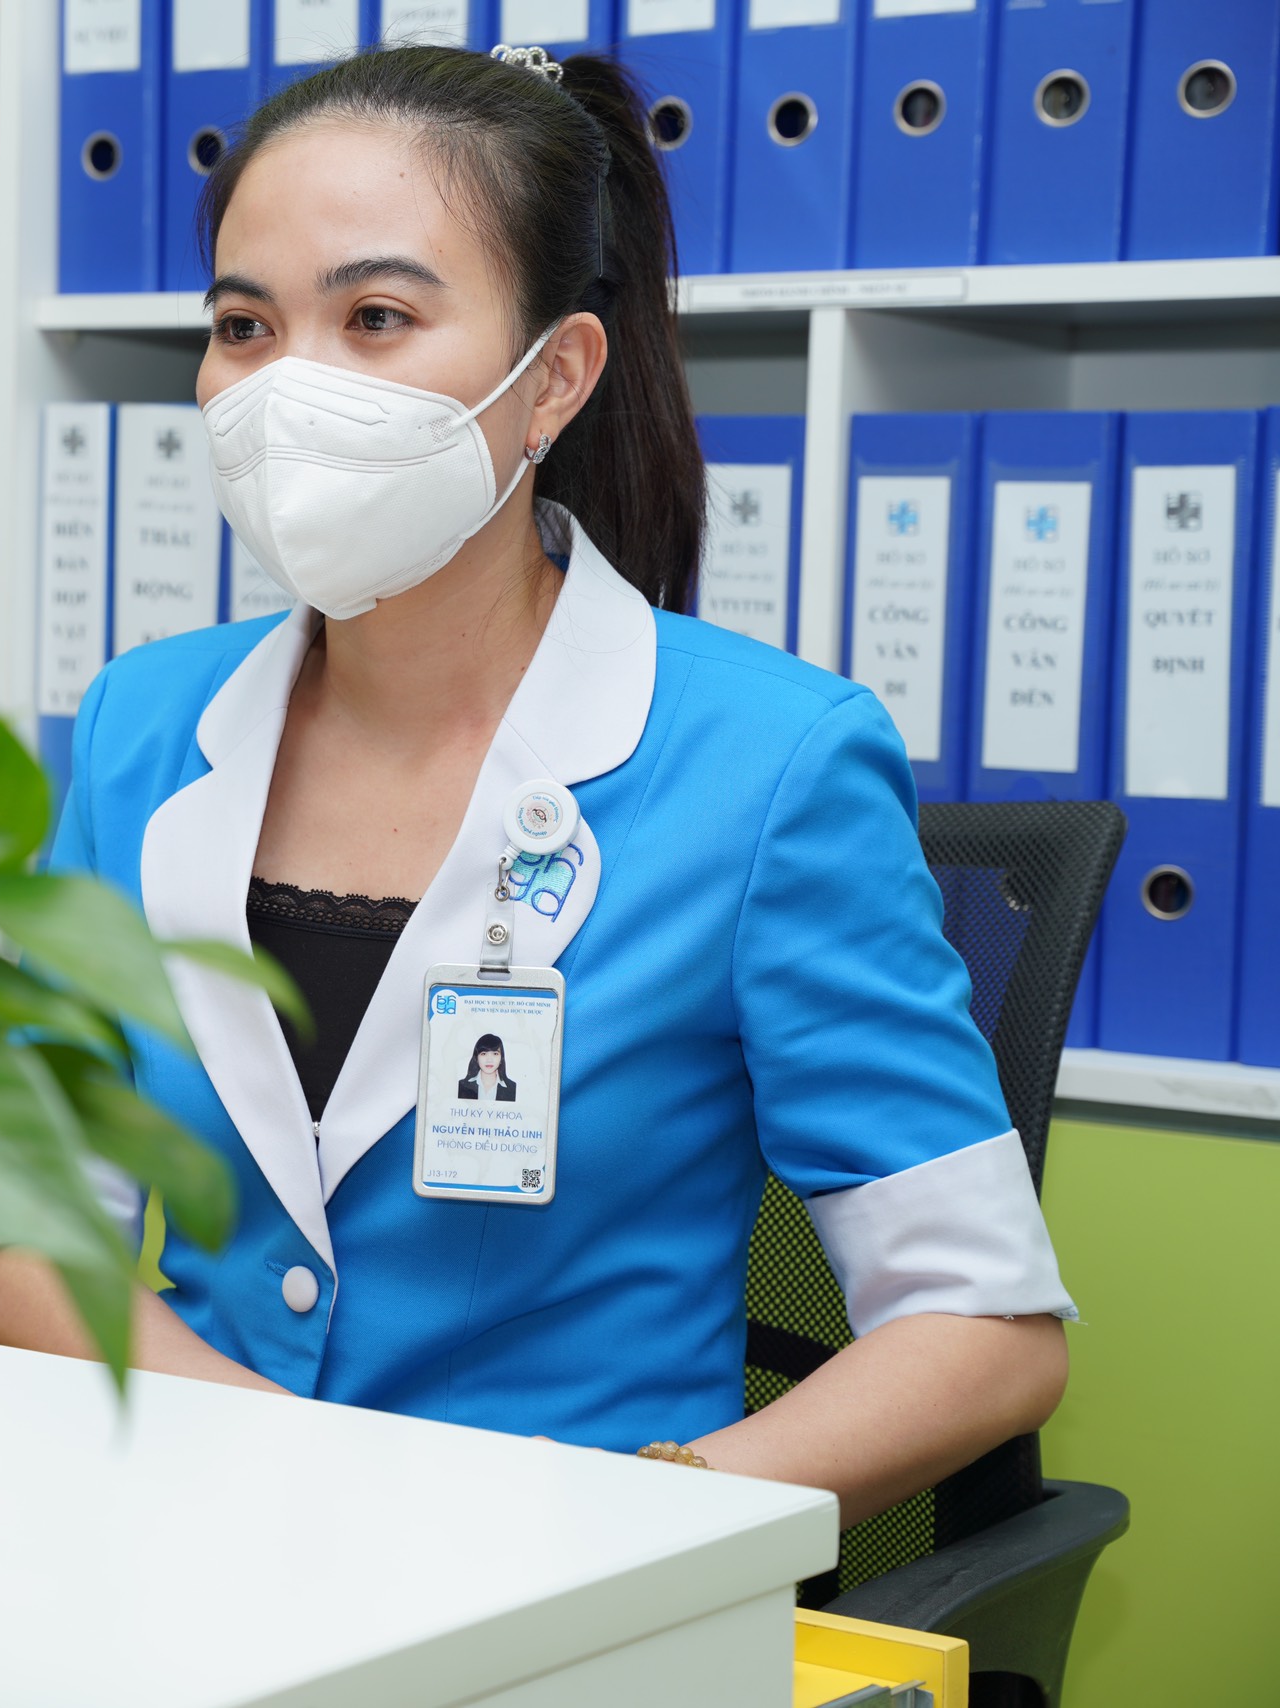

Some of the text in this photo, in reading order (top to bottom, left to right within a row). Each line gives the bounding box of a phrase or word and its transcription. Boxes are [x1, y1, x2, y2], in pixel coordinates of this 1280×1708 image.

[868, 603, 929, 623] CÔNG
[1004, 610, 1067, 632] CÔNG
[1145, 608, 1215, 629] QUYẾT
[876, 640, 918, 658] VĂN
[1011, 650, 1056, 668] VĂN
[1153, 656, 1205, 677] ĐỊNH
[1010, 687, 1054, 707] ĐẾN
[450, 1107, 523, 1120] THƯ KÝ Y KHOA
[432, 1123, 543, 1139] NGUYỄN THỊ THẢO LINH
[437, 1139, 472, 1150] PHÒNG
[475, 1140, 498, 1151] ĐIỀU
